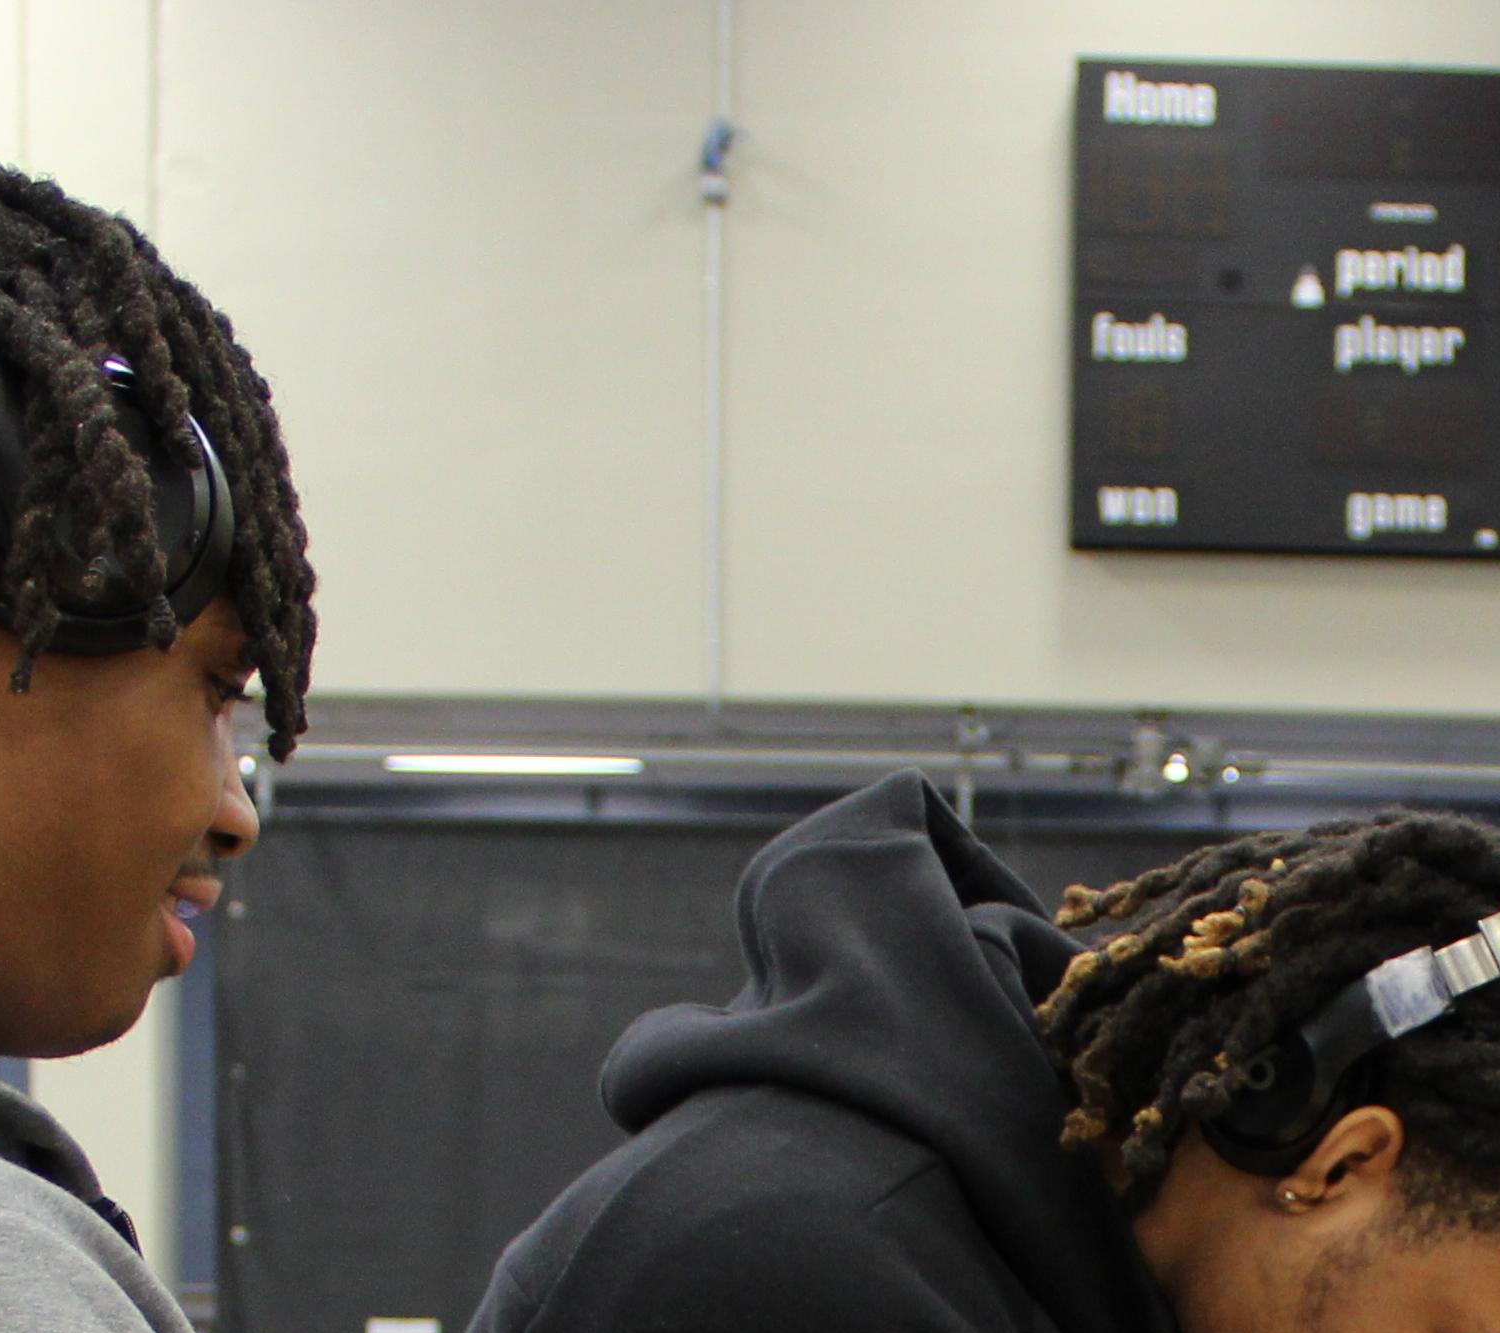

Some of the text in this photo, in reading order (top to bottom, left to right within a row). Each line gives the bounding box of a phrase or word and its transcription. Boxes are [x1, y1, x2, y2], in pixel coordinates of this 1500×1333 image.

[1103, 70, 1216, 127] Home
[1335, 244, 1466, 297] period
[1092, 312, 1187, 363] fouls
[1334, 314, 1464, 373] player
[1098, 485, 1179, 526] won
[1346, 491, 1446, 541] game
